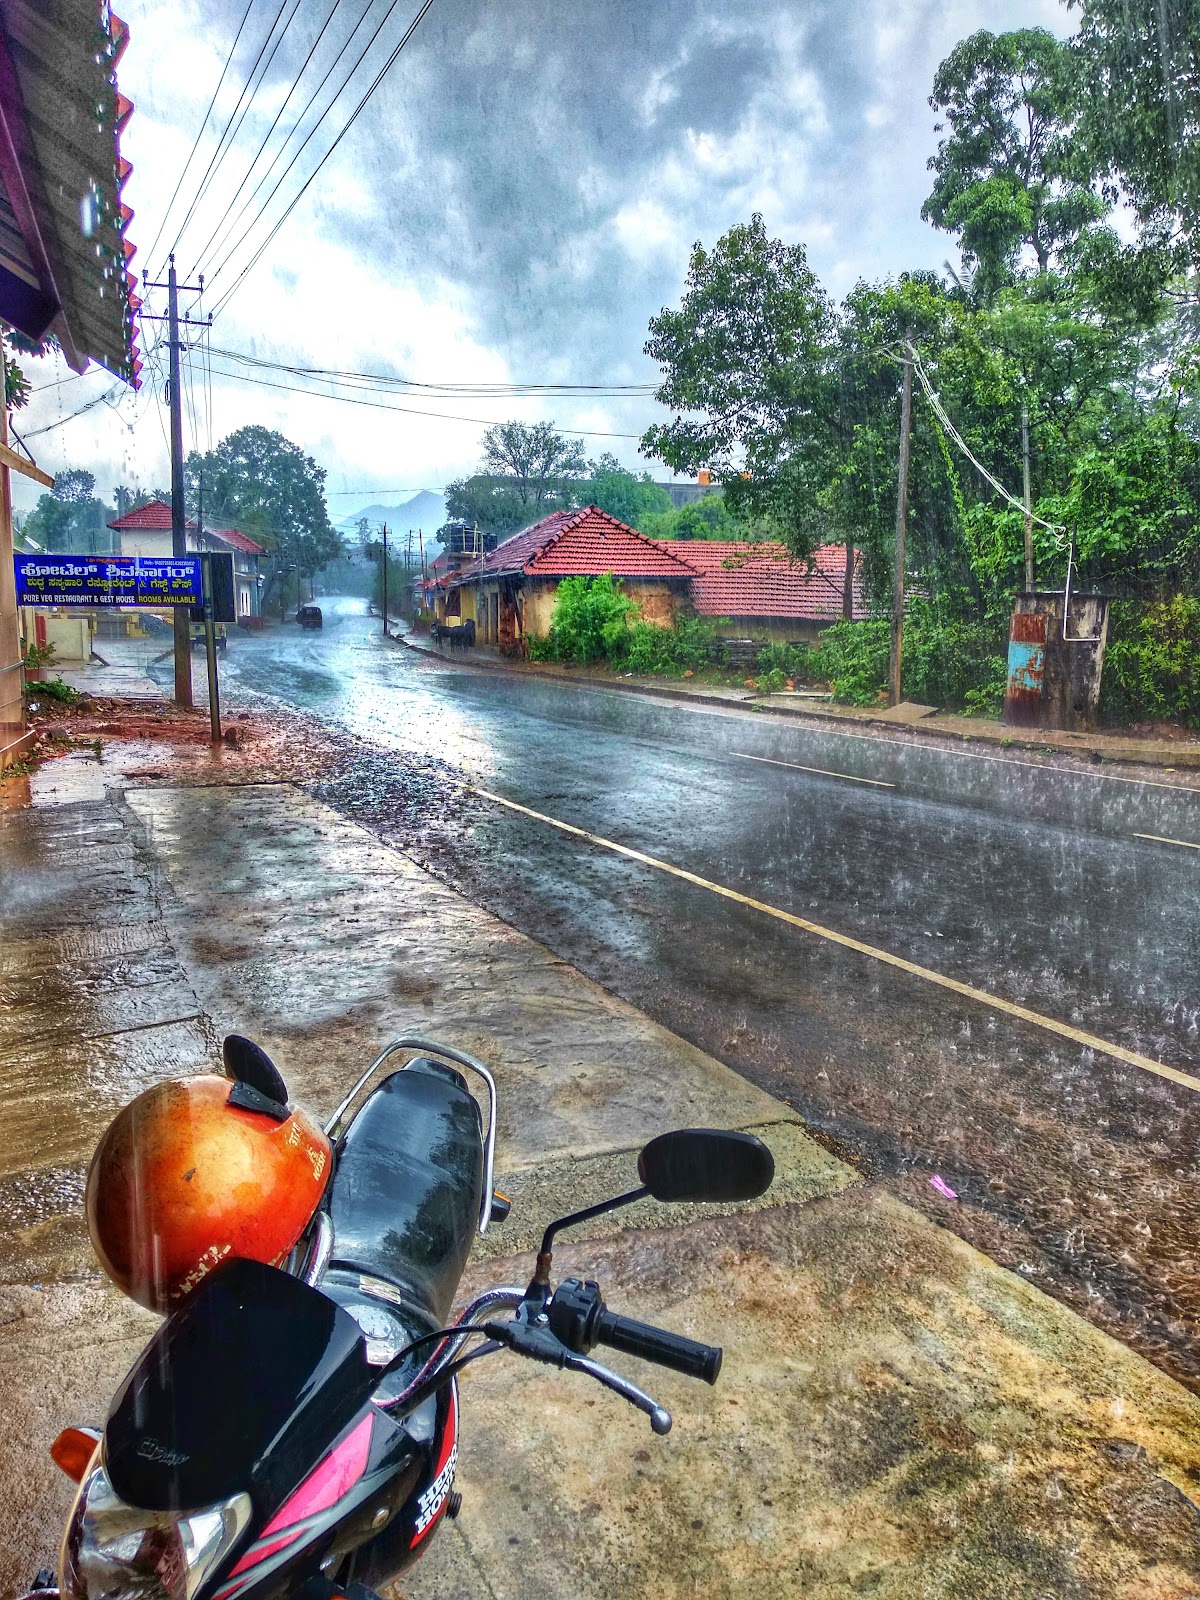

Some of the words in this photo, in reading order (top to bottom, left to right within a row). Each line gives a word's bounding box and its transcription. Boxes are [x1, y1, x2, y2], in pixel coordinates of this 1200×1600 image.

[139, 580, 146, 588] &
[23, 594, 39, 603] PURE
[40, 594, 53, 603] VEG
[54, 595, 92, 603] RESTAURANT
[93, 595, 99, 603] &
[99, 595, 114, 603] GEST
[116, 595, 135, 603] HOUSE
[163, 596, 196, 604] AVAILABLE
[417, 1443, 458, 1513] HERO
[414, 1472, 455, 1535] HON
